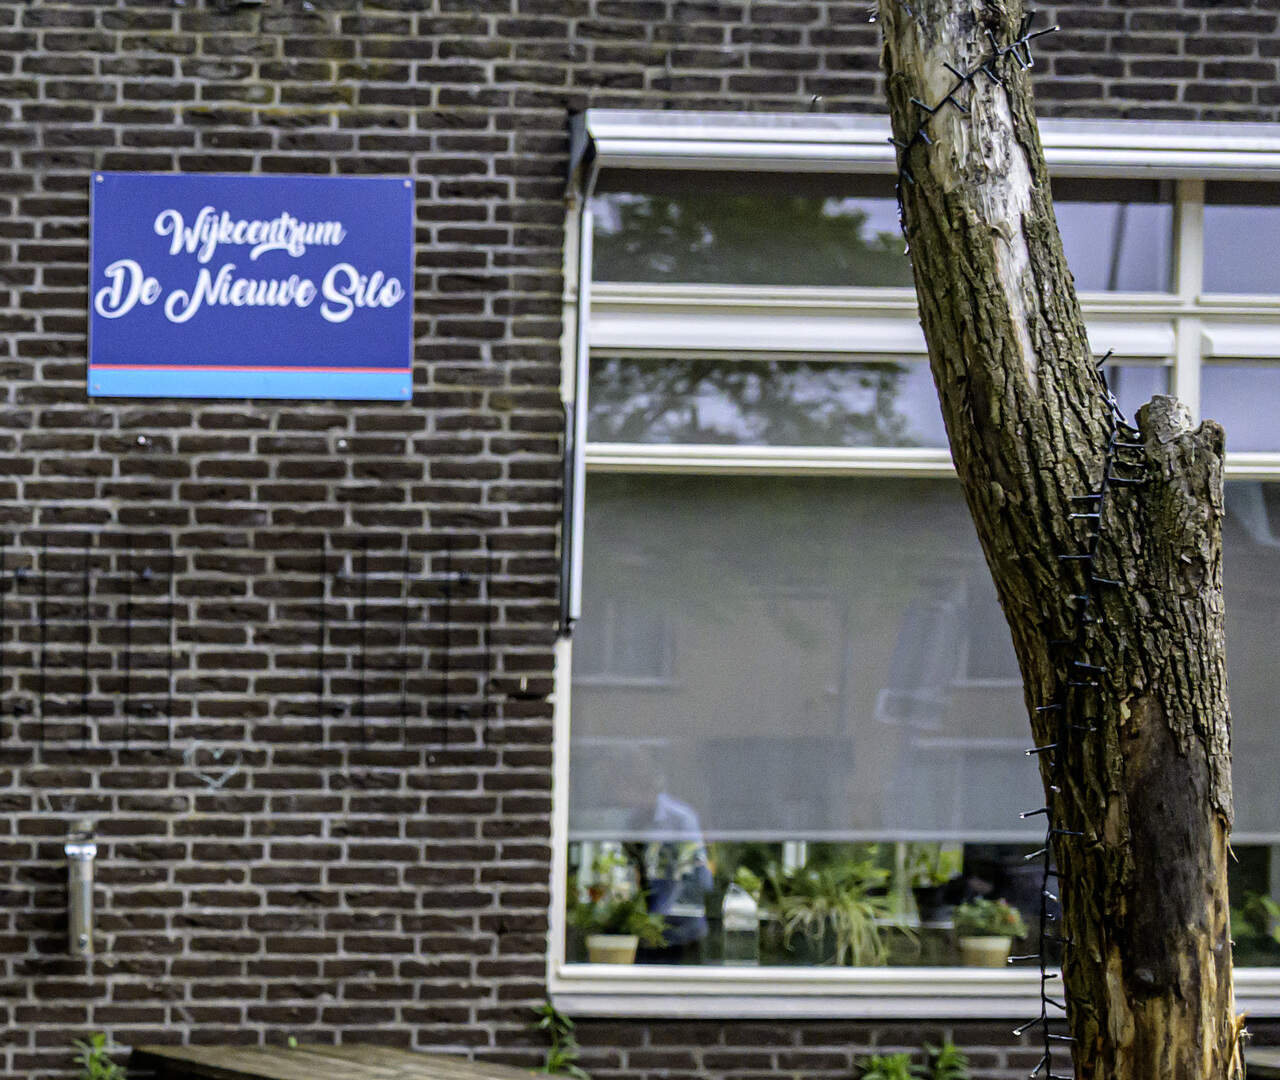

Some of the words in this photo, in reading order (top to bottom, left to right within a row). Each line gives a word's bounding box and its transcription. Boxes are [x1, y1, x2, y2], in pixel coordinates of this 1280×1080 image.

[153, 205, 347, 263] Wijkcentrum
[94, 259, 162, 319] De
[164, 262, 317, 323] Nieuwe
[320, 262, 406, 323] Silo
